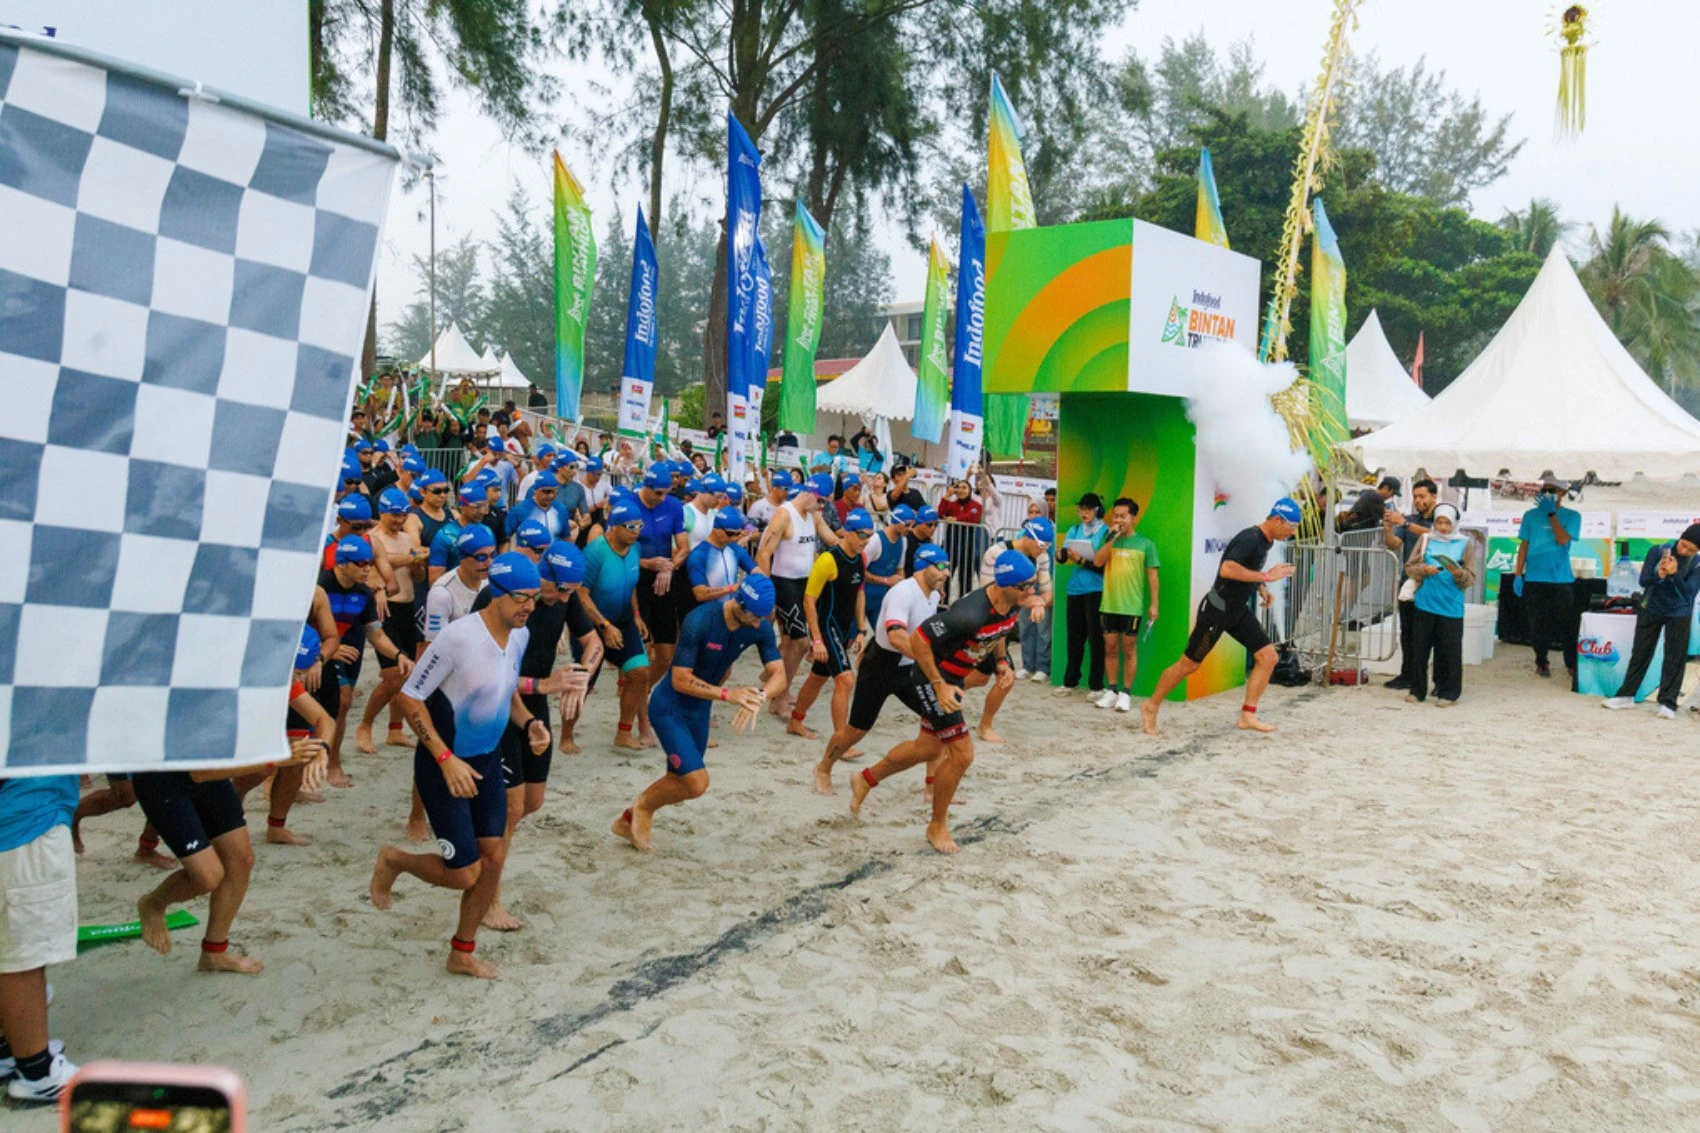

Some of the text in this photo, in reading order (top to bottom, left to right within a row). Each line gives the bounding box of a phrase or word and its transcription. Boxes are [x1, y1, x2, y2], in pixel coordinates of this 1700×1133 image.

[1188, 309, 1236, 339] BINTAN
[1577, 639, 1612, 655] Club
[415, 654, 440, 690] PURPOSE
